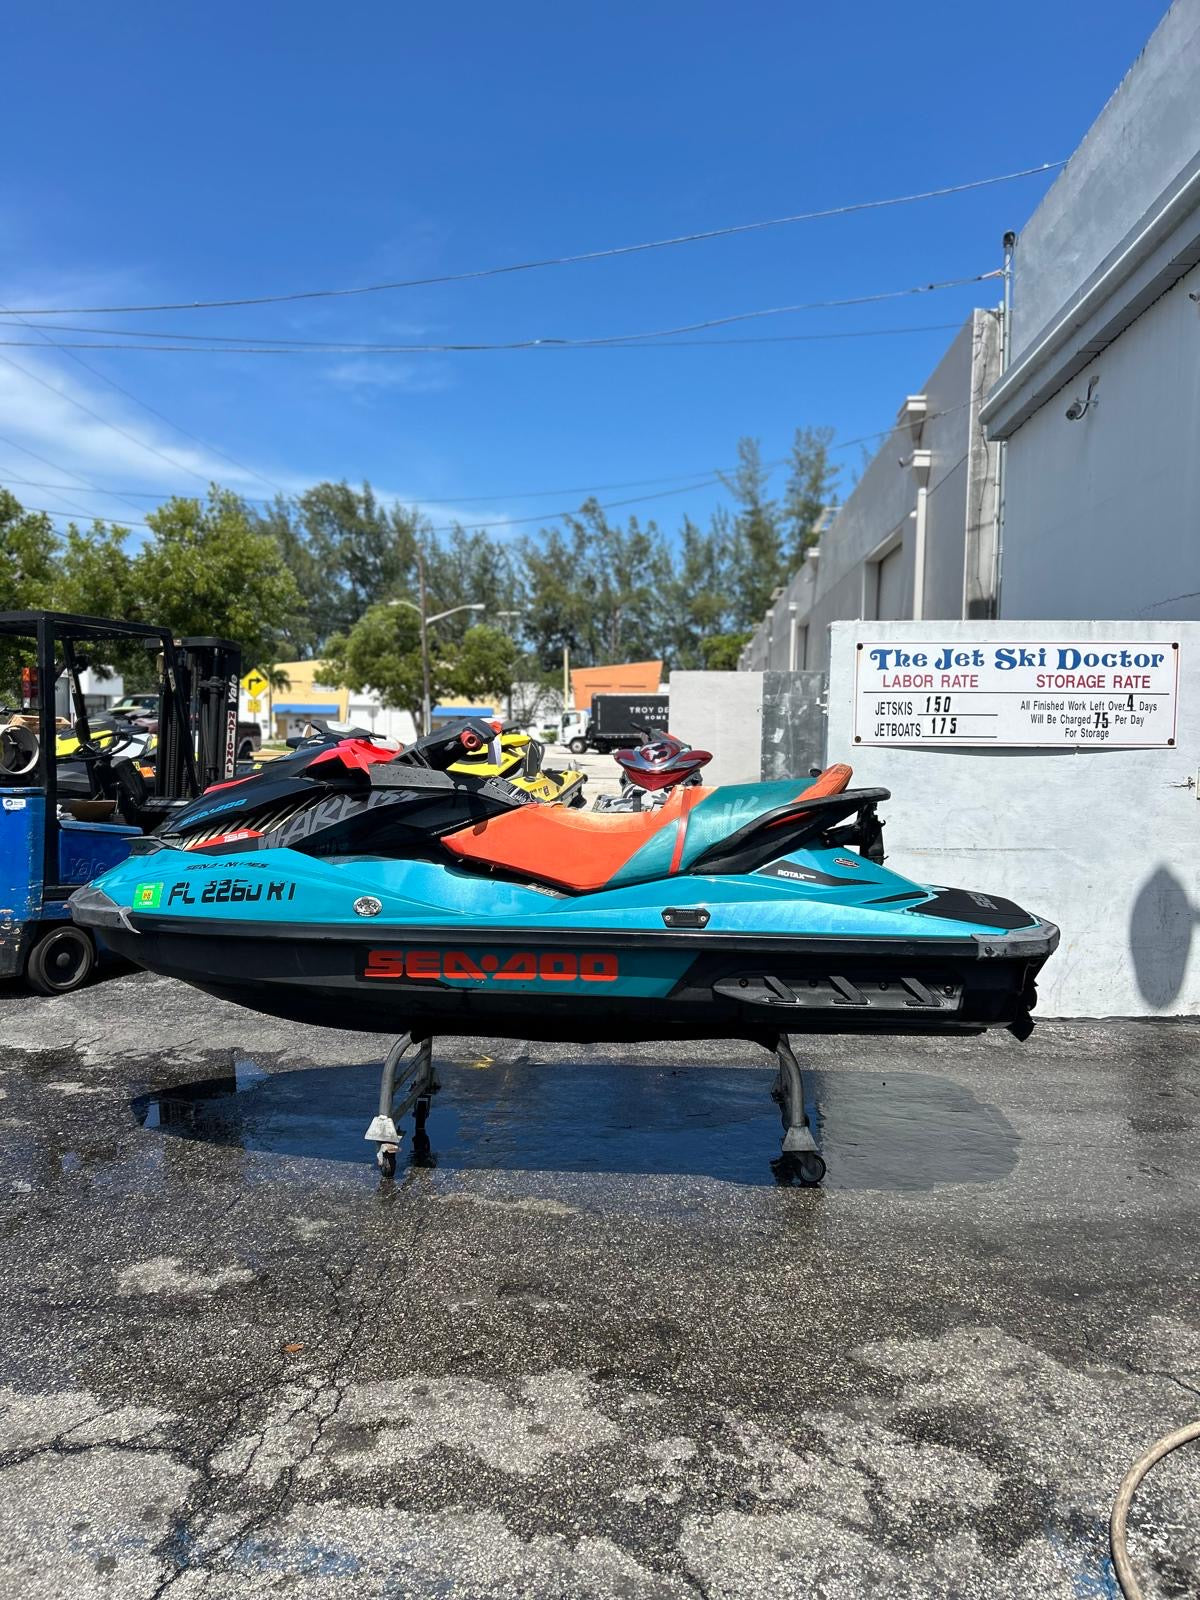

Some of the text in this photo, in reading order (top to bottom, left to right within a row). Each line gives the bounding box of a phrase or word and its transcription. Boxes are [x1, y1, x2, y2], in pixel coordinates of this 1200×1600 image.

[870, 649, 1165, 671] The Jet Ski Doctor
[883, 675, 978, 688] LABOR RATE
[1036, 675, 1150, 688] STORAGE RATE
[875, 696, 951, 715] JETSKIS 150
[1020, 694, 1157, 712] All Finished Work Left Over 4 Days
[875, 718, 957, 736] JETBOATS 175
[1031, 712, 1144, 729] Will Be Charged 75 Per Day
[226, 712, 236, 772] NATIONAL
[1065, 728, 1109, 739] For Storage
[778, 870, 806, 880] ROTAX
[168, 882, 195, 906] FL
